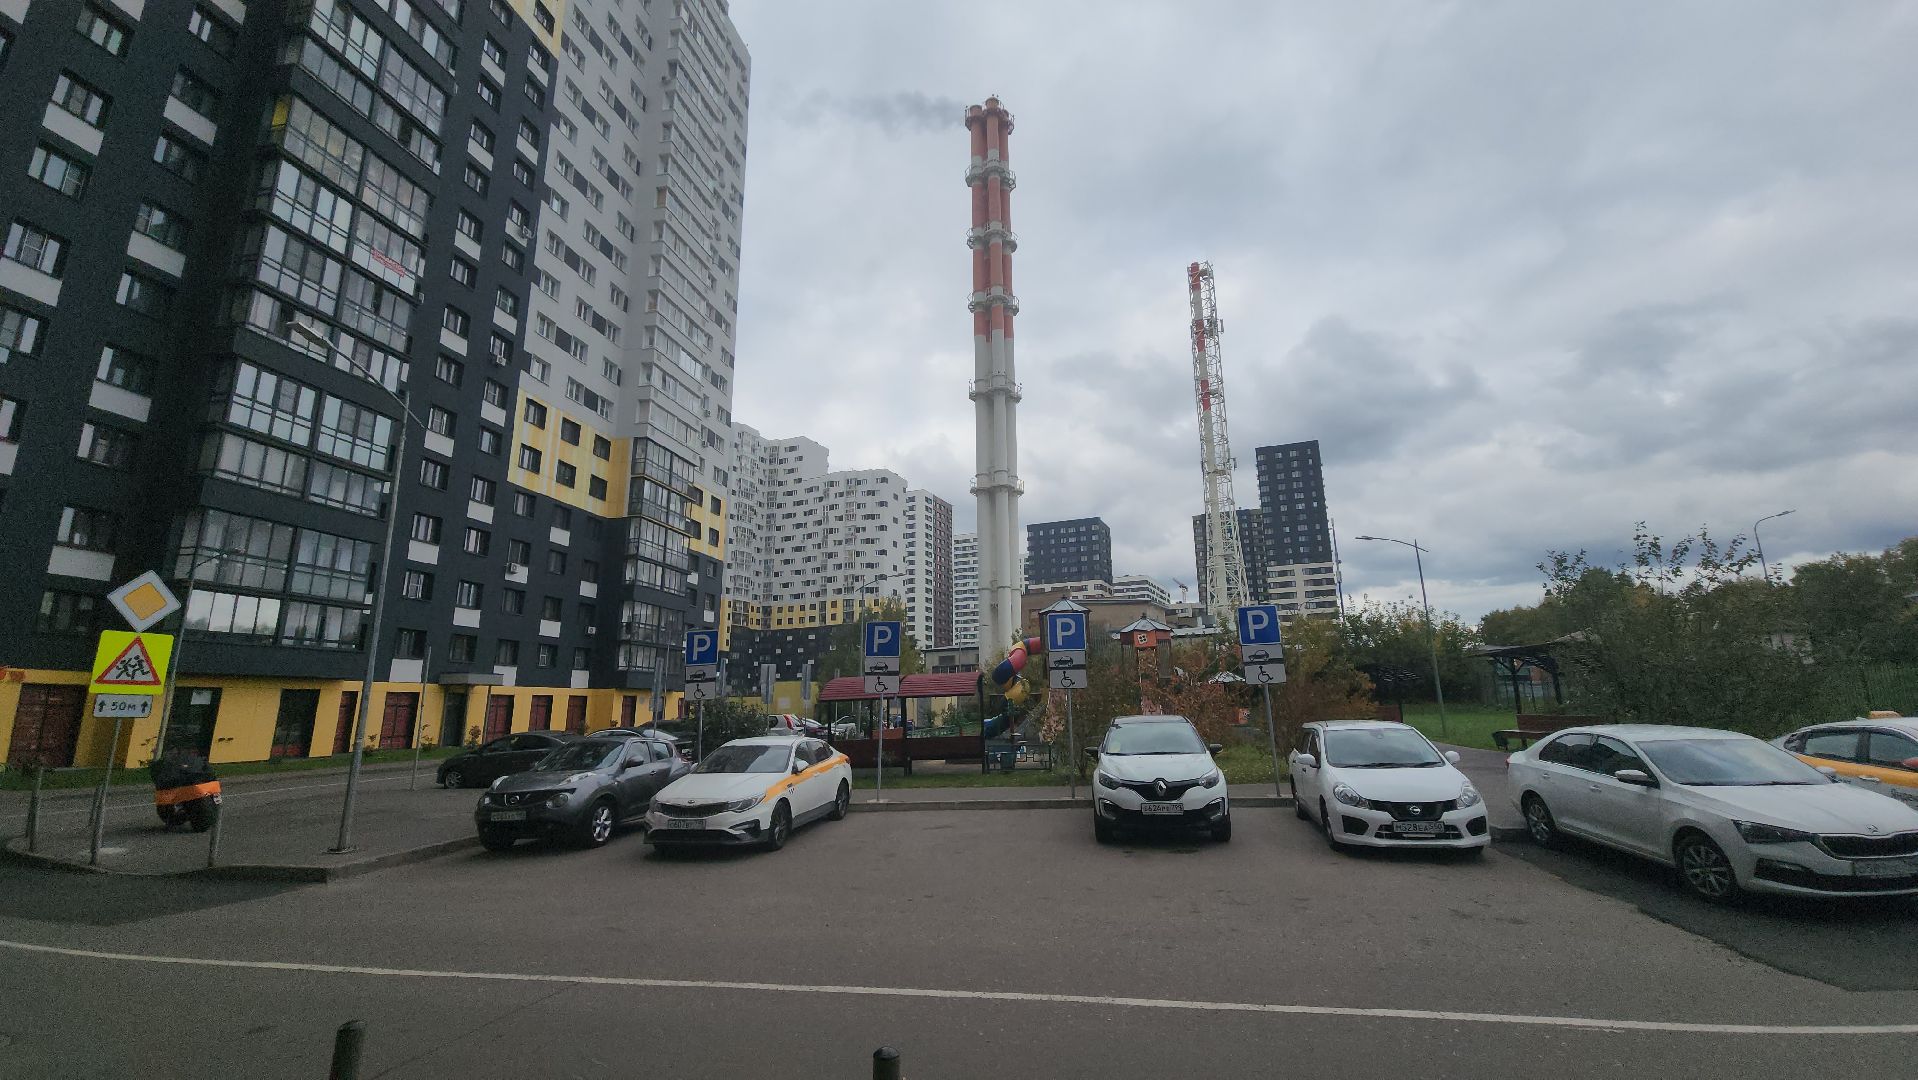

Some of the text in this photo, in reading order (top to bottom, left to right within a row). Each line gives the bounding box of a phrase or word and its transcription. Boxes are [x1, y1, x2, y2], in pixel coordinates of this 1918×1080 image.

[874, 625, 892, 653] P
[1056, 617, 1076, 646] P
[1246, 610, 1269, 640] P
[693, 634, 711, 661] P
